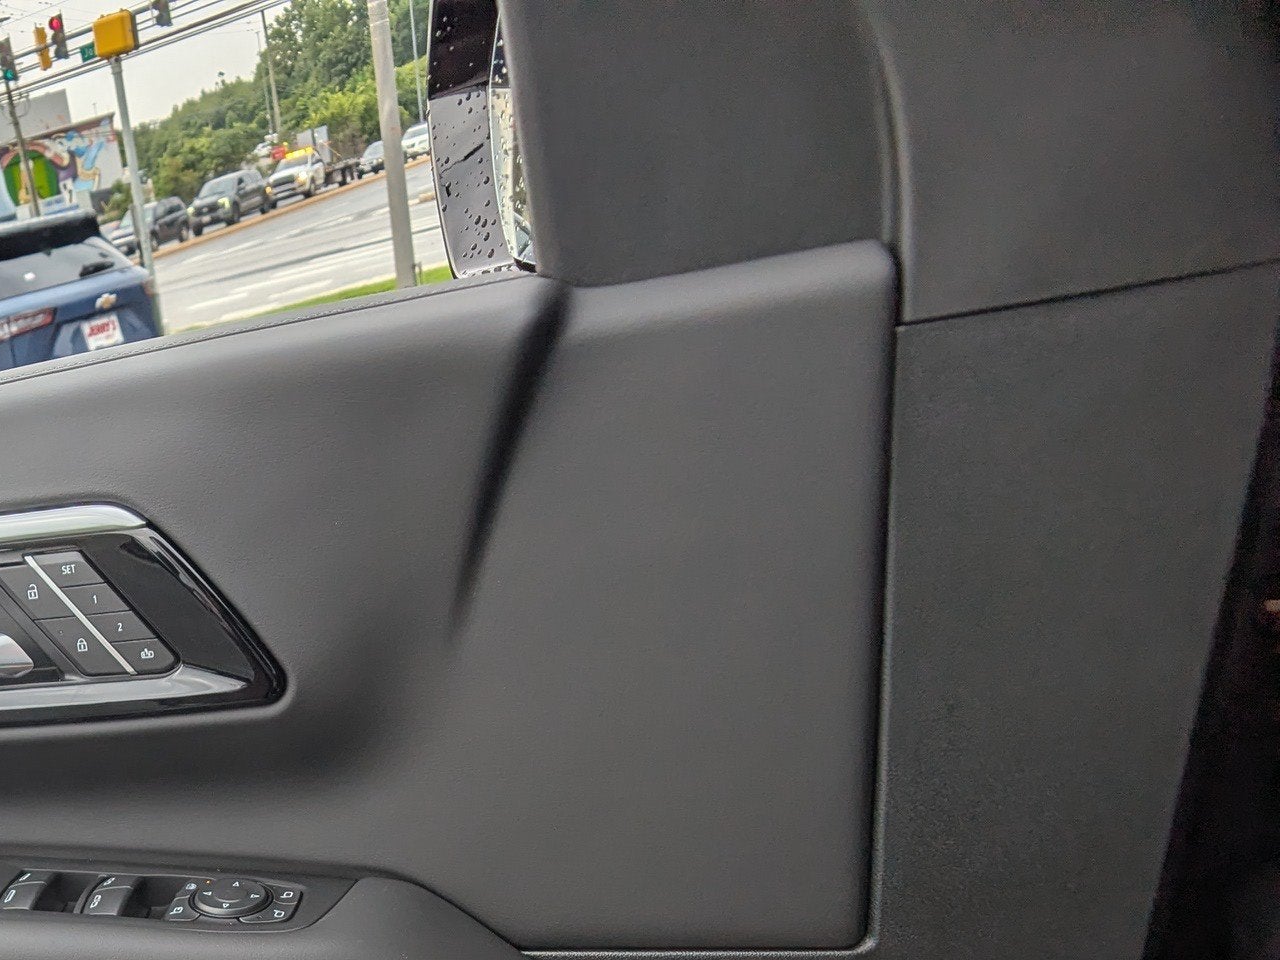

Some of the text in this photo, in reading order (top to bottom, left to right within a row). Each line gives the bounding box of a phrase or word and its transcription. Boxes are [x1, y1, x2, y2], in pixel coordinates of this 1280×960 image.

[61, 564, 76, 575] SET
[92, 594, 98, 605] 1
[117, 622, 123, 632] 2
